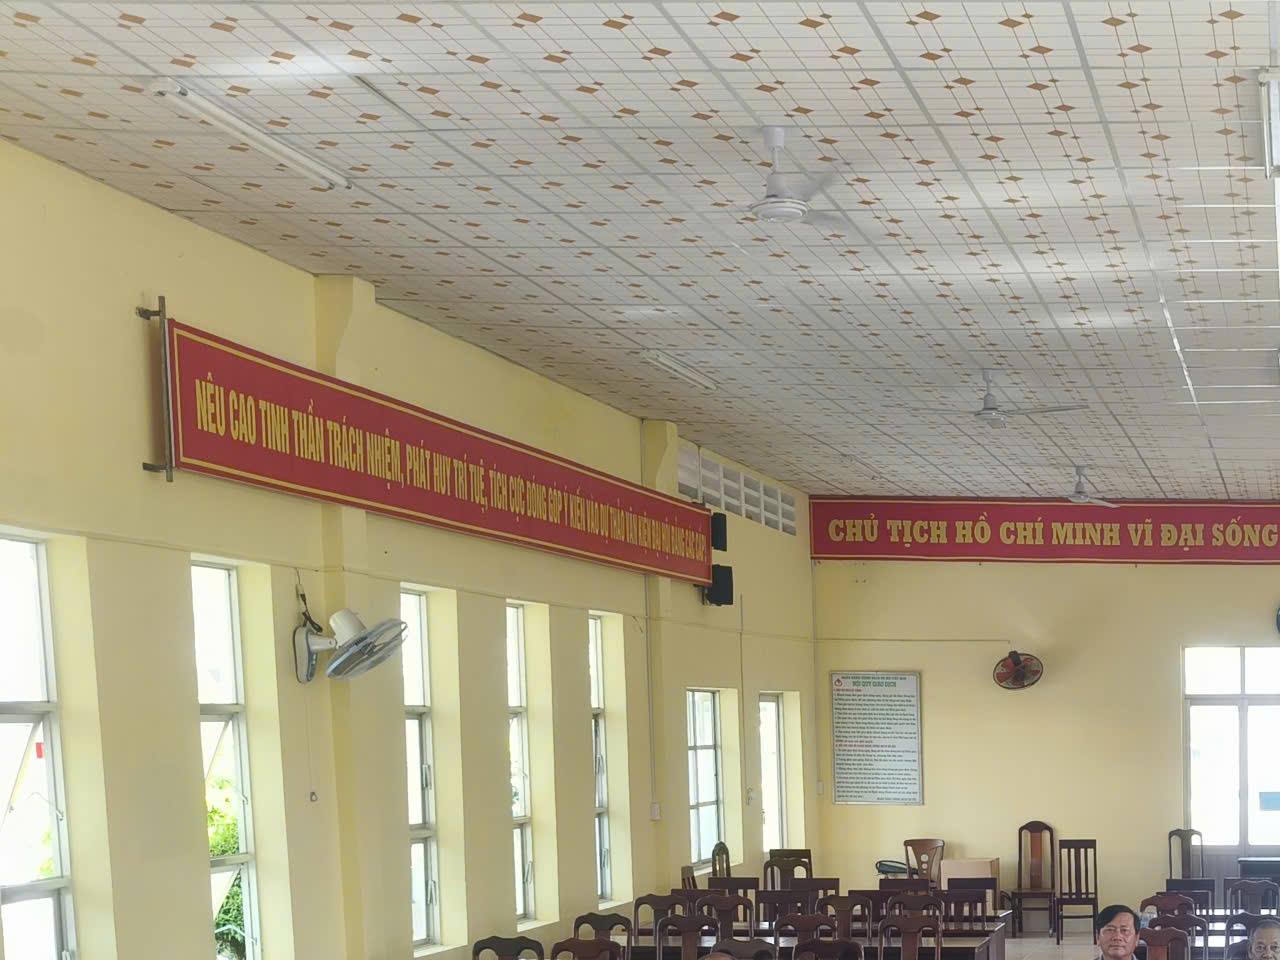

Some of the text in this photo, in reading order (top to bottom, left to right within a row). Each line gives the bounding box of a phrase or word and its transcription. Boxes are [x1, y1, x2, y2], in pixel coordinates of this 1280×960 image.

[195, 371, 226, 437] NÊU
[229, 389, 257, 446] CAO
[259, 399, 290, 455] TINH
[292, 398, 325, 464] THẦN
[326, 415, 364, 473] TRÁCH
[366, 428, 404, 490] NHIỆM,
[405, 439, 431, 491] PHÁT
[433, 452, 451, 496] HUY
[453, 453, 468, 501] TRÍ
[469, 458, 488, 513] TUỆ,
[489, 463, 508, 511] TÍCH
[509, 474, 525, 522] CỰC
[526, 474, 547, 521] ĐÓNG
[548, 481, 562, 524] GÓP
[569, 486, 586, 532] KIẾN
[828, 513, 878, 542] CHỦ
[886, 520, 947, 548] TỊCH
[955, 511, 992, 544] HỒ
[999, 516, 1044, 546] CHÍ
[1051, 522, 1121, 546] MINH
[1127, 518, 1154, 547] VĨ
[1160, 523, 1205, 551] ĐẠI
[1211, 515, 1278, 547] SỐNG
